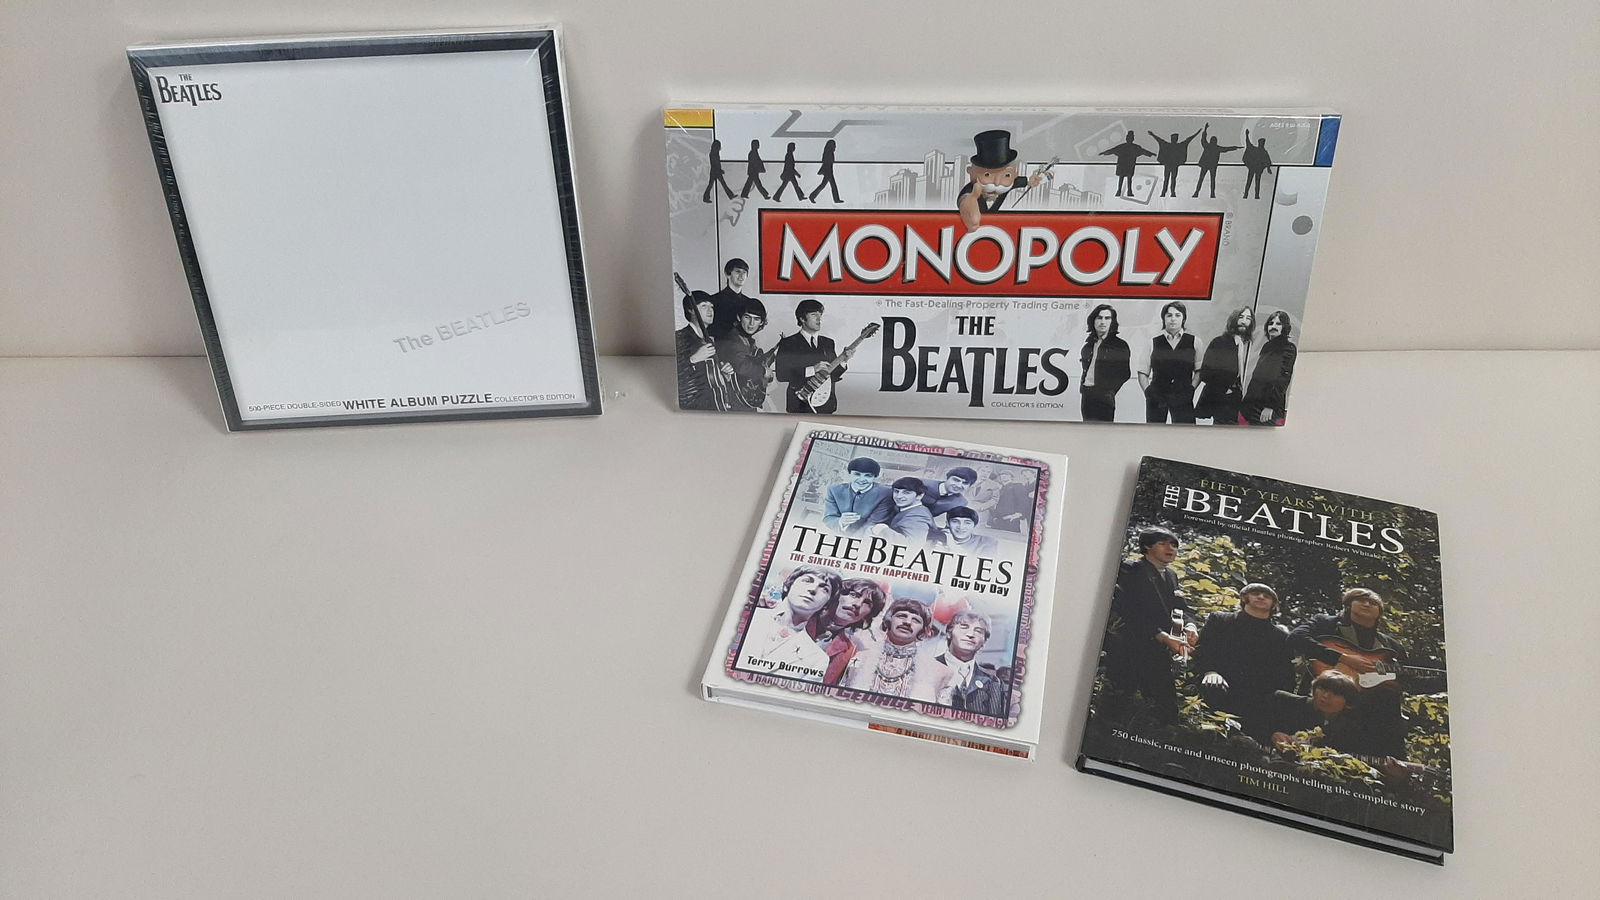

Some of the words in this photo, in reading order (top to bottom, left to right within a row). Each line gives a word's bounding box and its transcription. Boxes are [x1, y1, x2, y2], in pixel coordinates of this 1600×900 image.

[155, 75, 222, 106] BEATLES
[178, 73, 192, 81] THE
[776, 222, 1205, 285] MONOPOLY
[885, 299, 903, 308] The
[905, 299, 964, 310] Fast-Dealing
[966, 300, 1010, 311] Property
[1012, 300, 1048, 311] Trading
[1051, 301, 1080, 310] Game
[392, 334, 434, 353] The
[435, 301, 532, 341] BEATLES
[955, 315, 996, 335] THE
[879, 316, 1069, 408] BEATLES
[287, 400, 342, 410] DOUBLE-SIDED
[342, 398, 387, 410] WHITE
[390, 396, 438, 408] ALBUM
[441, 393, 493, 405] PUZZLE
[494, 394, 545, 403] COLLECTOR'S
[545, 393, 576, 401] EDITION
[991, 401, 1035, 409] COLLECTOR'S
[1162, 484, 1180, 508] THE
[1200, 479, 1251, 496] FIFTY
[1257, 490, 1315, 509] YEARS
[1322, 503, 1373, 521] WITH
[1181, 487, 1404, 554] BEATLES
[1183, 514, 1216, 525] Foreword
[1218, 519, 1226, 528] by
[1227, 523, 1250, 532] official
[1251, 527, 1276, 537] Beatles
[1277, 532, 1324, 547] photographer
[1326, 543, 1350, 552] Robert
[789, 553, 805, 563] THE
[807, 556, 842, 568] SIXTIES
[844, 562, 856, 571] AS
[859, 563, 881, 575] THEY
[883, 568, 930, 582] HAPPENED
[792, 524, 862, 561] THE
[863, 535, 1014, 586] BEATLES
[951, 577, 970, 591] Day
[973, 583, 987, 594] by
[990, 585, 1010, 597] Day
[747, 656, 776, 669] Terry
[779, 661, 824, 677] Burrows
[1112, 729, 1129, 740] 750
[1130, 734, 1162, 749] classic,
[1164, 744, 1183, 754] rare
[1184, 749, 1202, 758] and
[1204, 754, 1237, 768] unseen
[1240, 762, 1300, 784] photographs
[1302, 778, 1333, 793] telling
[1335, 785, 1351, 796] the
[1353, 791, 1398, 808] complete
[1400, 804, 1426, 816] story
[1238, 774, 1260, 787] TIM
[1263, 781, 1289, 795] HILL
